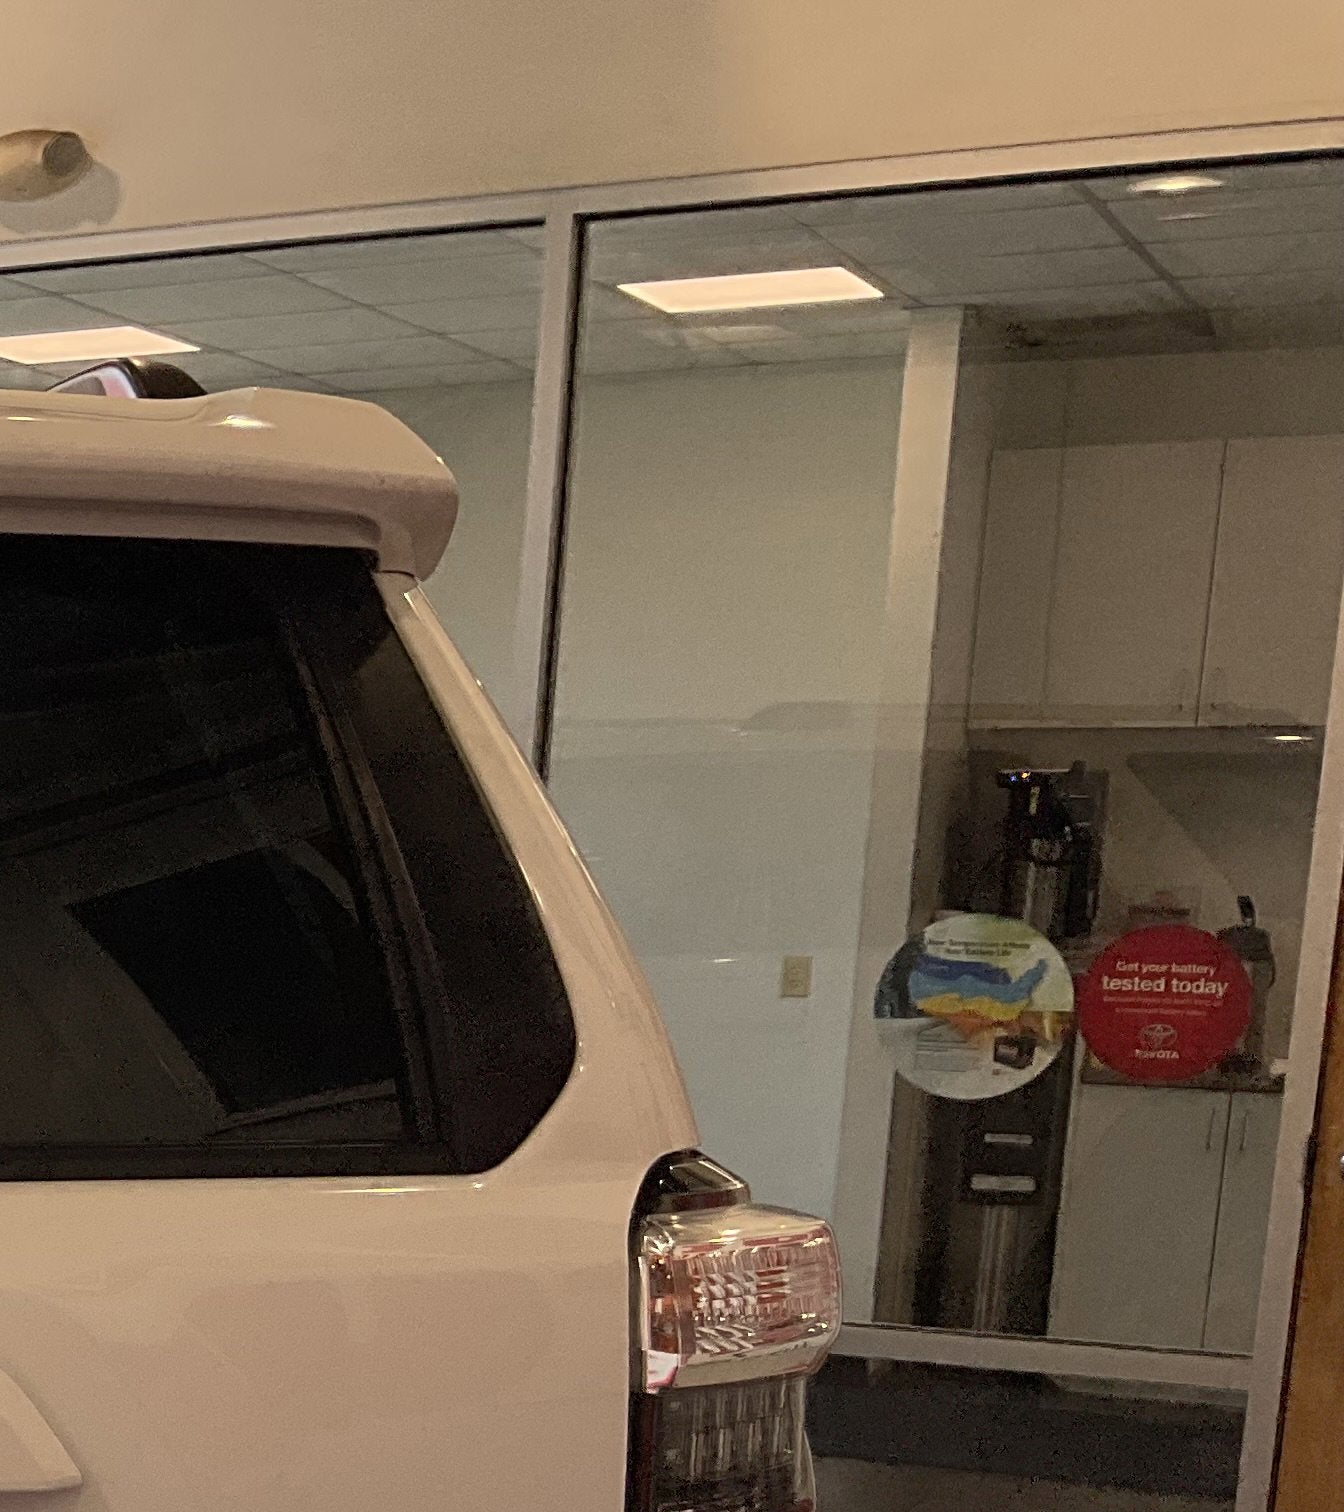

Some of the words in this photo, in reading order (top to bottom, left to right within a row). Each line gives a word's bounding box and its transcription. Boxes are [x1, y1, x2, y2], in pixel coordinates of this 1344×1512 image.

[1115, 960, 1140, 972] Get
[1142, 963, 1169, 974] your
[1171, 962, 1217, 976] battery
[1101, 975, 1167, 993] tested
[1171, 977, 1229, 999] today
